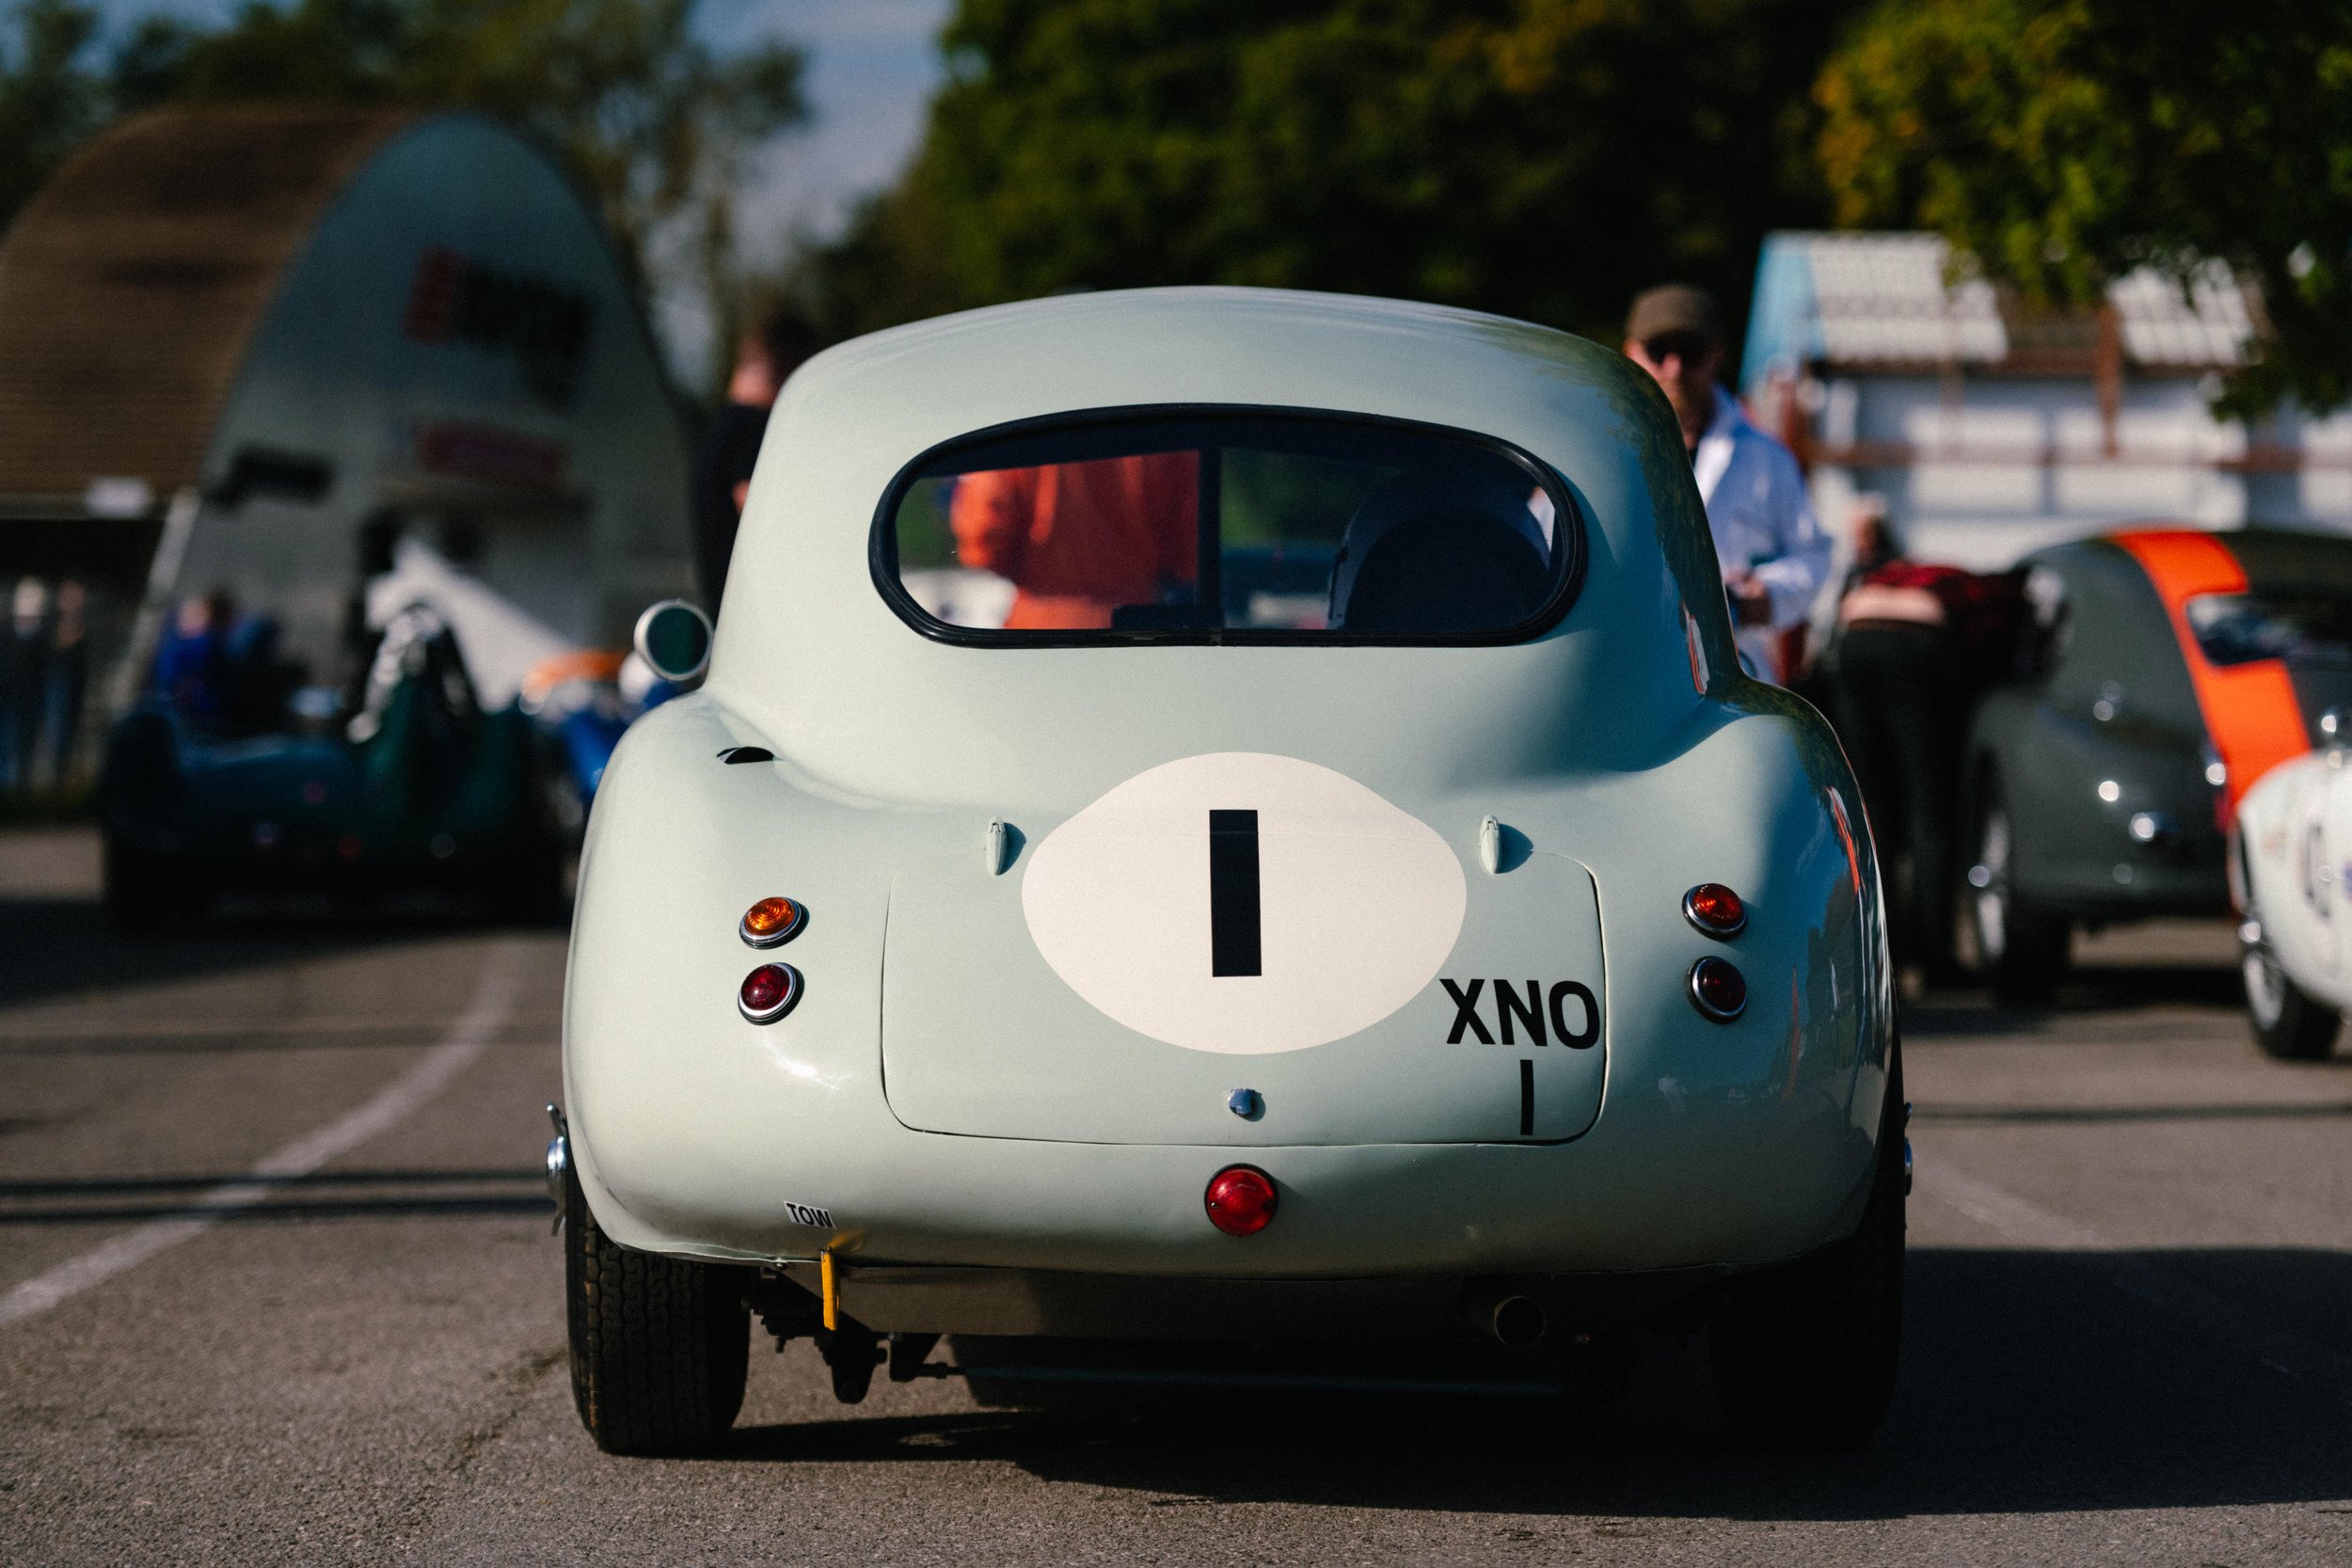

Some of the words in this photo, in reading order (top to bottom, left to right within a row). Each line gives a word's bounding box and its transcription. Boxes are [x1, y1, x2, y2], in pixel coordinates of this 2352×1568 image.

[1210, 810, 1263, 977] 1
[1439, 978, 1601, 1050] XNO
[786, 1202, 834, 1228] TOW
